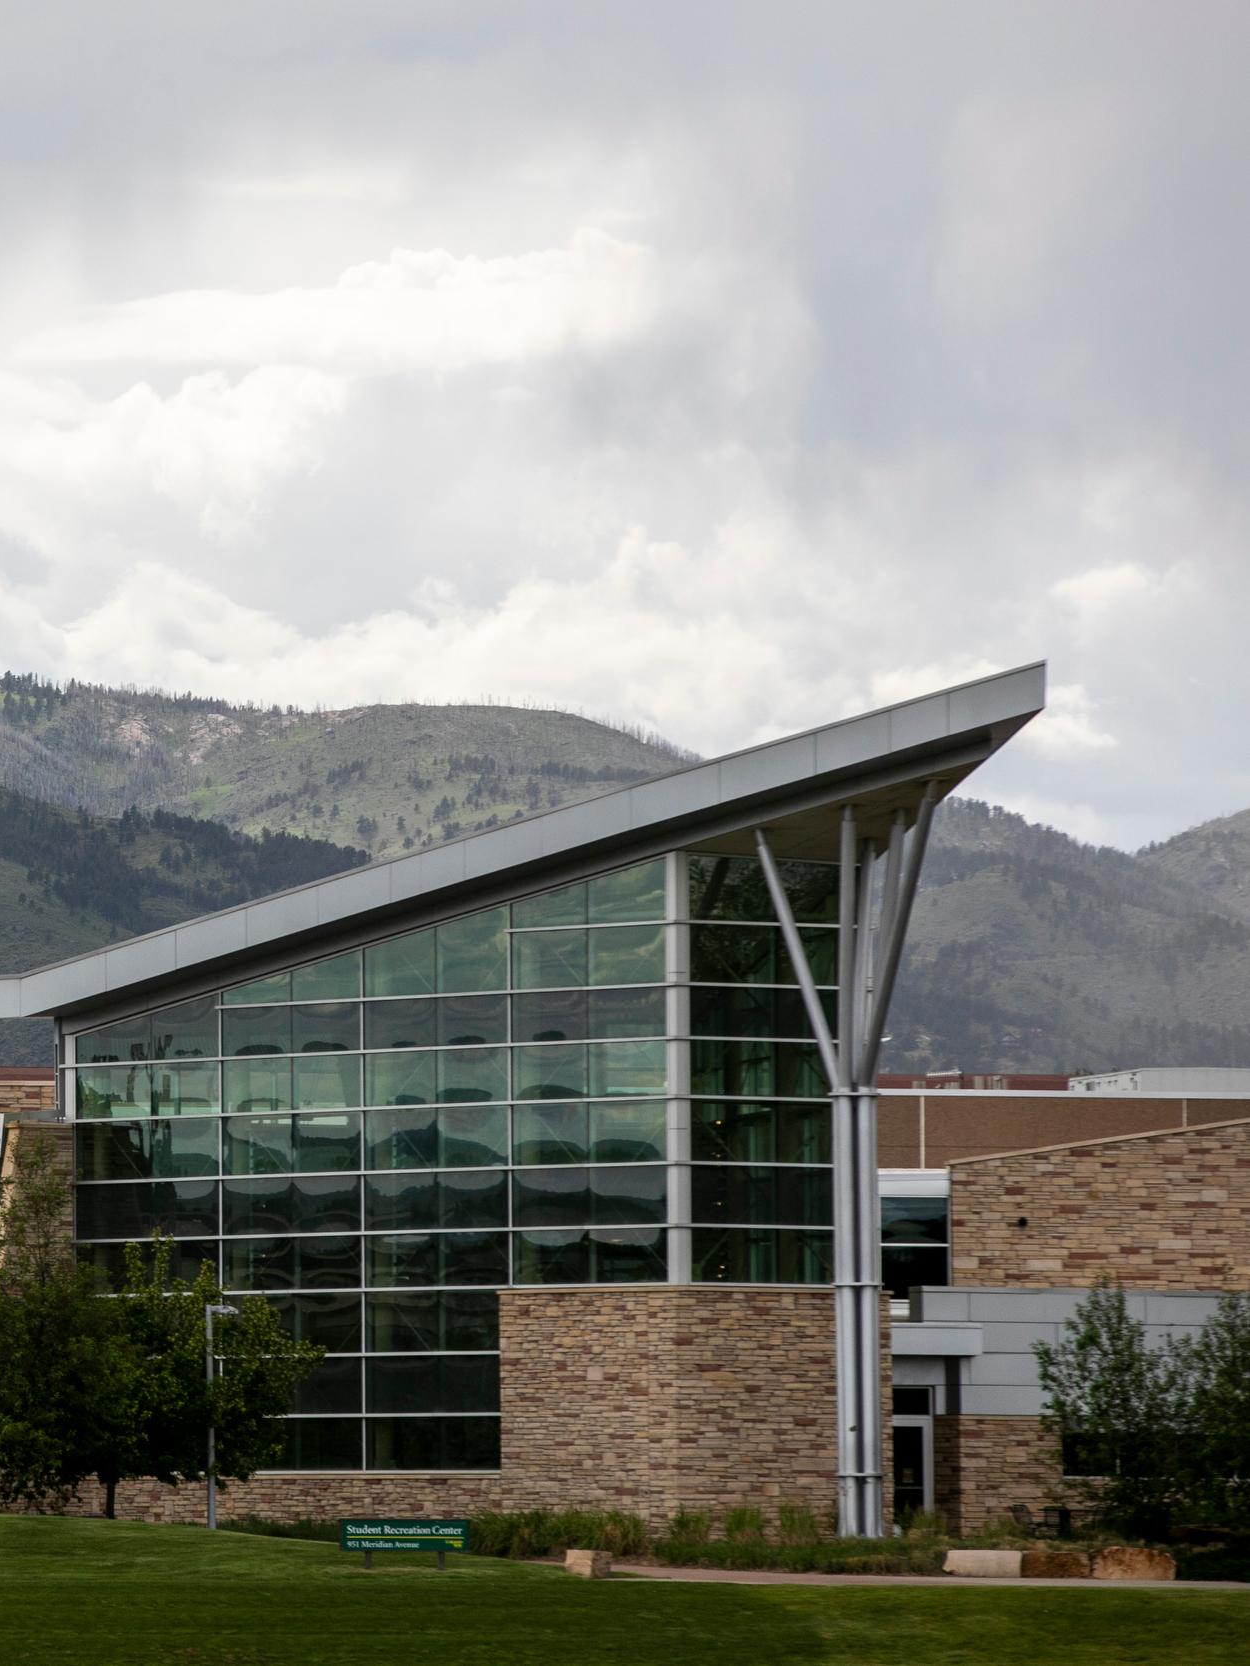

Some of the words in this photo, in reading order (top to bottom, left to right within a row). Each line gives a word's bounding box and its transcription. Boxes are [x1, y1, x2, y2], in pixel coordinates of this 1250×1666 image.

[347, 1525, 381, 1535] Student
[384, 1525, 431, 1535] Recreation
[432, 1525, 463, 1535] Center
